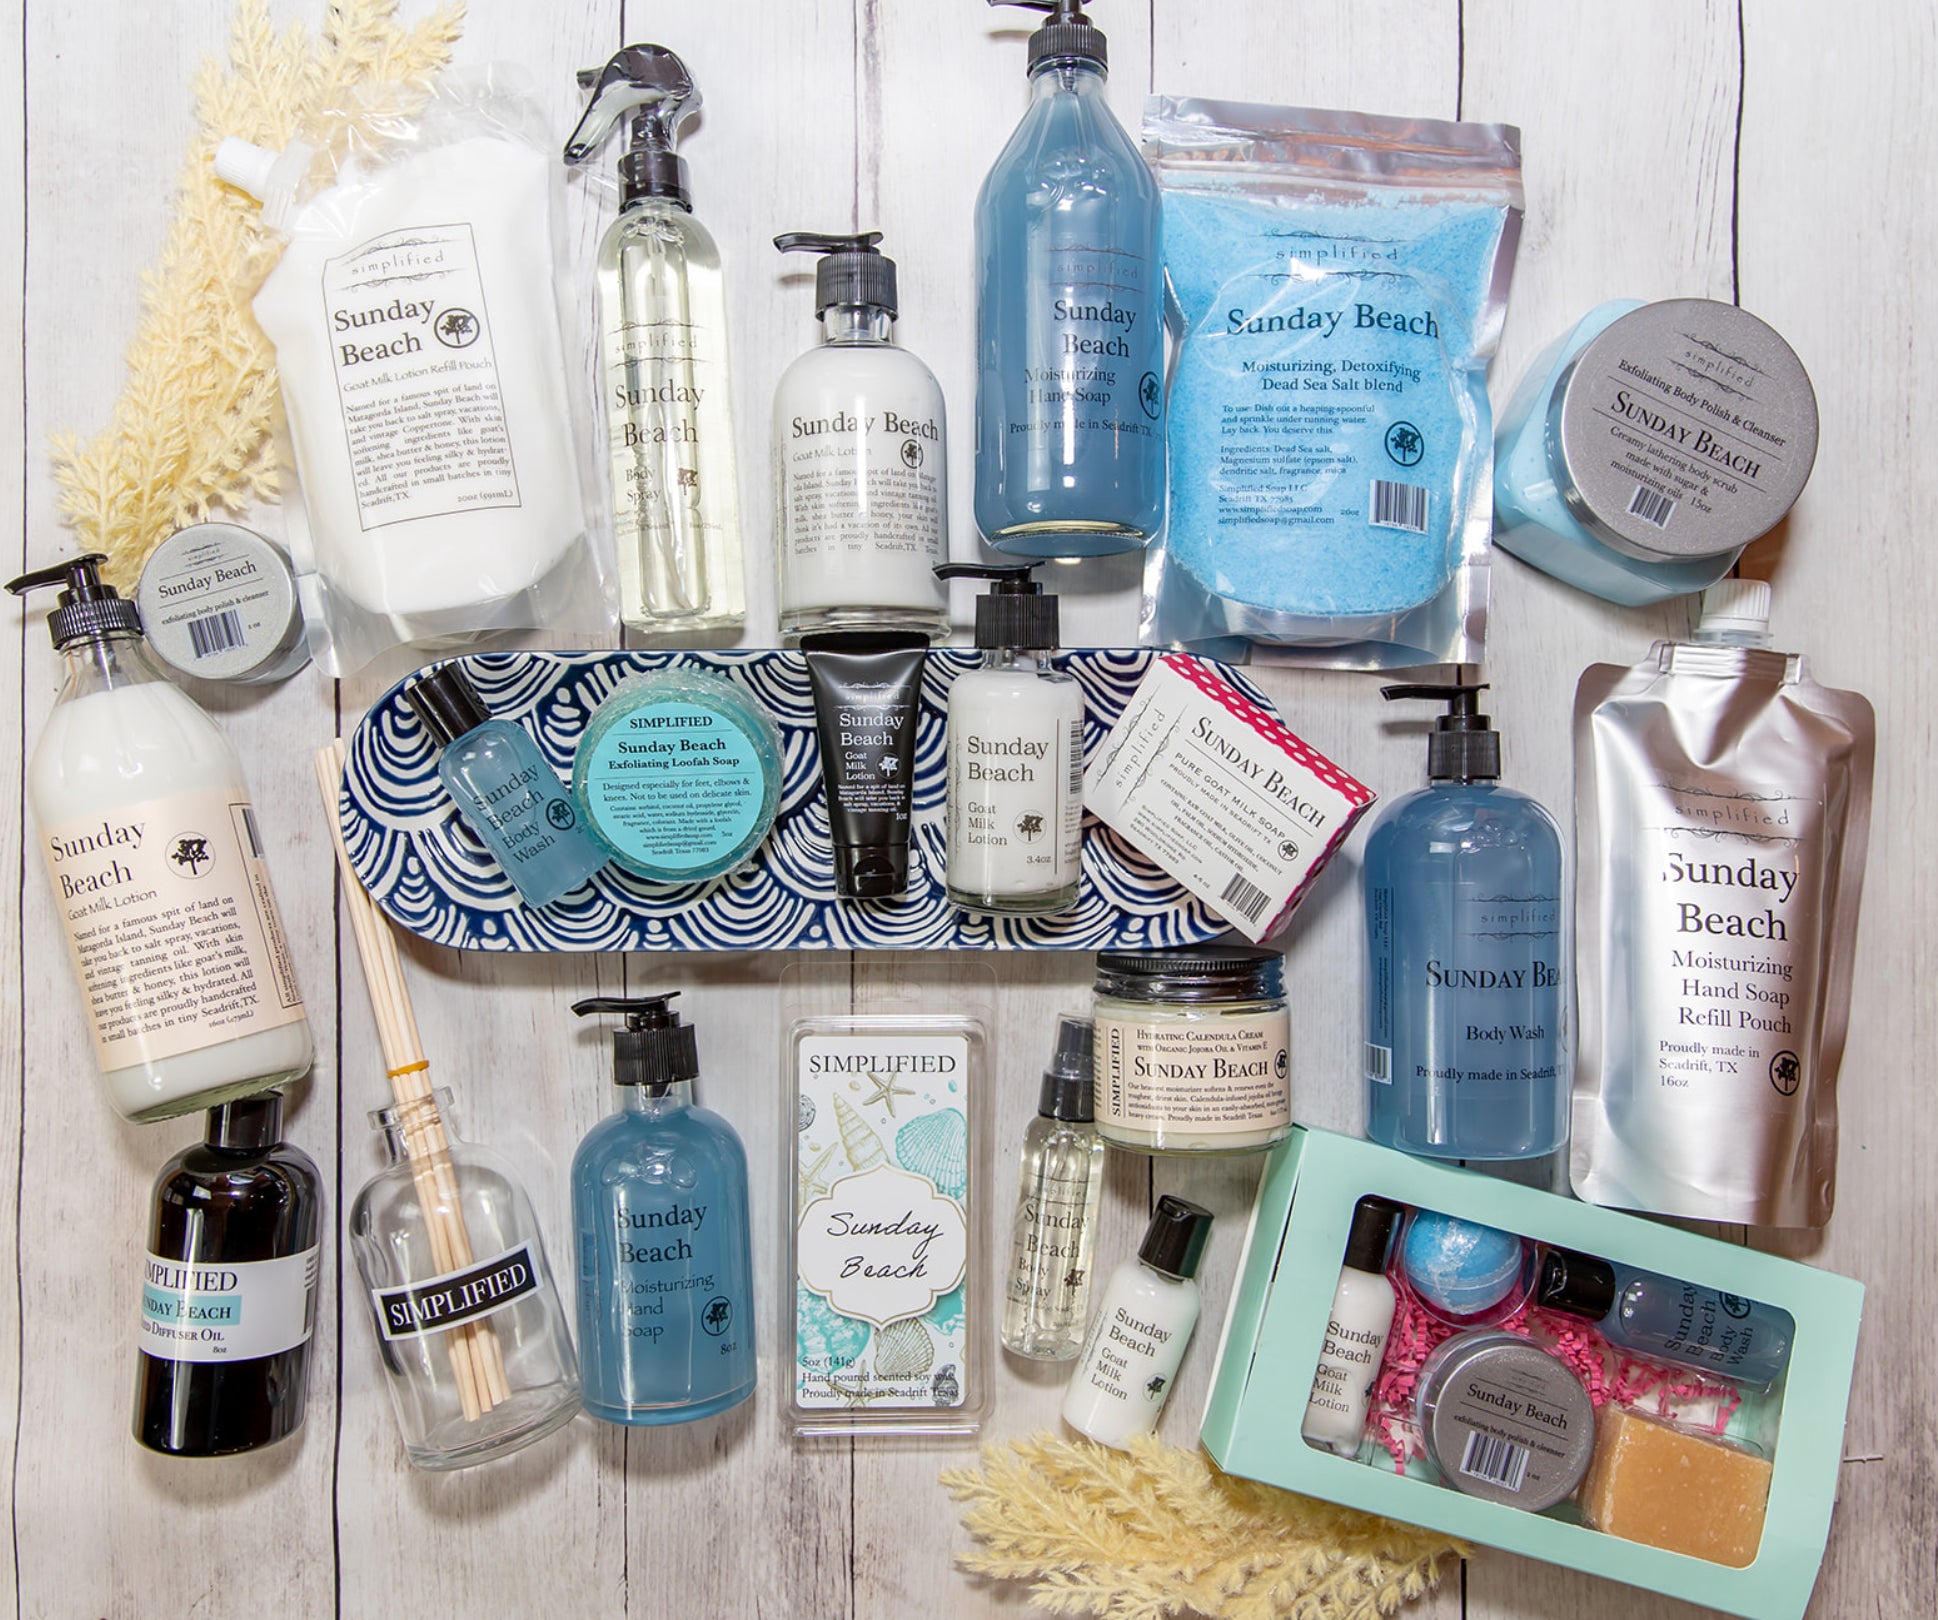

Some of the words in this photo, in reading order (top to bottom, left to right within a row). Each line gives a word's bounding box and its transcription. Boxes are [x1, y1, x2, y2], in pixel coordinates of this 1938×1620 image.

[351, 252, 444, 275] simplified
[1276, 245, 1398, 266] simplified
[335, 299, 435, 332] Sunday
[1054, 300, 1136, 332] Sunday
[1226, 308, 1344, 338] Sunday
[1354, 304, 1440, 339] Beach
[339, 332, 422, 367] Beach
[1062, 333, 1130, 358] Beach
[343, 377, 369, 393] Goat
[370, 374, 393, 388] Milk
[394, 368, 429, 383] Lotion
[430, 362, 457, 374] Refill
[459, 357, 492, 371] Pouch
[1242, 360, 1336, 376] Moisturizing,
[1342, 360, 1421, 382] Detoxifying
[1685, 350, 1754, 388] simplified
[615, 379, 705, 410] Sunday
[1075, 387, 1111, 406] Soap
[1262, 379, 1298, 391] Dead
[1303, 380, 1328, 391] Sea
[1332, 379, 1359, 390] Salt
[1364, 378, 1402, 393] blend
[1618, 359, 1673, 394] Exfoliating
[1672, 386, 1700, 407] Body
[1699, 399, 1731, 422] Polish
[1733, 414, 1742, 426] &
[1742, 419, 1786, 447] Cleanser
[623, 419, 698, 447] Beach
[792, 411, 875, 438] Sunday
[883, 411, 939, 441] Beach
[1610, 426, 1647, 451] Creamy
[1647, 439, 1688, 472] lathering
[1689, 459, 1712, 482] body
[1713, 475, 1739, 495] scrub
[1625, 450, 1652, 467] made
[1653, 463, 1673, 479] with
[1673, 473, 1699, 492] sugar
[1700, 486, 1710, 496] &
[626, 466, 656, 482] Body
[1610, 459, 1666, 494] moisturizing
[1667, 486, 1683, 499] oils
[627, 488, 661, 505] Spray
[159, 576, 212, 599] Sunday
[215, 561, 257, 583] Beach
[162, 611, 196, 625] exfoliating
[198, 606, 213, 616] body
[215, 599, 235, 611] polish
[630, 716, 712, 729] SIMPLIFIED
[839, 713, 904, 730] Sunday
[618, 741, 675, 756] Sunday
[680, 738, 726, 750] Beach
[840, 732, 893, 746] Beach
[967, 736, 1049, 760] Sunday
[1115, 709, 1166, 787] simplified
[609, 760, 669, 770] Exfoliating
[673, 757, 710, 767] Loofah
[713, 756, 739, 767] Soap
[845, 752, 867, 760] Goat
[846, 762, 866, 770] Milk
[846, 772, 875, 780] Lotion
[968, 762, 1034, 782] Beach
[1169, 763, 1200, 787] PROUDLY
[1200, 787, 1220, 806] MADE
[473, 764, 540, 811] Sunday
[603, 782, 640, 792] Designed
[642, 780, 679, 790] especially
[682, 779, 693, 787] for
[1175, 753, 1201, 776] PURE
[1203, 774, 1230, 797] GOAT
[1231, 795, 1258, 818] MILK
[1259, 817, 1286, 839] SOAP
[486, 790, 544, 831] Beach
[968, 802, 996, 814] Goat
[1675, 804, 1789, 825] simplified
[502, 821, 540, 849] Body
[968, 818, 994, 829] Milk
[50, 821, 146, 862] Sunday
[512, 835, 556, 863] Wash
[968, 833, 1008, 846] Lotion
[1027, 856, 1052, 864] 3.4oz
[60, 860, 133, 899] Beach
[1663, 853, 1799, 903] Sunday
[68, 908, 88, 921] Goat
[89, 900, 112, 917] Milk
[114, 889, 157, 907] Lotion
[122, 914, 158, 930] famous
[199, 899, 220, 911] land
[149, 920, 185, 935] Sunday
[189, 910, 219, 925] Beach
[1481, 908, 1556, 928] simplified
[1677, 902, 1788, 941] Beach
[130, 951, 168, 967] tanning
[1671, 950, 1793, 982] Moisturizing
[1681, 978, 1739, 1000] Hand
[1746, 982, 1790, 1009] Soap
[1678, 1006, 1732, 1027] Refill
[1738, 1011, 1792, 1033] Pouch
[1466, 1025, 1507, 1044] Body
[1509, 1025, 1545, 1040] Wash
[1660, 1040, 1708, 1056] Proudly
[1712, 1043, 1746, 1057] made
[1748, 1046, 1760, 1058] in
[810, 1055, 956, 1073] SIMPLIFIED
[1112, 1028, 1121, 1116] SIMPLIFIED
[1468, 1070, 1502, 1080] made
[1506, 1070, 1517, 1080] in
[1659, 1057, 1712, 1073] Seadrift,
[1715, 1060, 1738, 1073] TX
[1660, 1075, 1689, 1088] 16oz
[618, 1205, 707, 1231] Sunday
[827, 1210, 944, 1259] Sunday
[1027, 1234, 1080, 1258] Beach
[620, 1239, 692, 1263] Beach
[840, 1255, 928, 1278] Beach
[390, 1264, 527, 1327] SIMPLIFIED
[621, 1274, 715, 1294] Moisturizing
[1115, 1307, 1172, 1344] Sunday
[1664, 1283, 1697, 1351] Sunday
[1685, 1300, 1717, 1356] Beach
[1109, 1325, 1156, 1357] Beach
[1327, 1320, 1383, 1348] Sunday
[1709, 1325, 1737, 1362] Body
[1727, 1327, 1753, 1365] Wash
[802, 1357, 820, 1367] 5oz
[1102, 1347, 1128, 1368] Goat
[1323, 1340, 1372, 1364] Beach
[802, 1372, 830, 1382] Hand
[834, 1372, 870, 1386] poured
[873, 1372, 911, 1382] scented
[914, 1373, 931, 1384] soy
[1096, 1360, 1121, 1382] Milk
[1317, 1363, 1348, 1381] Goat
[802, 1388, 841, 1400] Proudly
[845, 1389, 873, 1398] made
[875, 1388, 885, 1397] in
[888, 1387, 928, 1397] Seadrift
[1091, 1374, 1127, 1400] Lotion
[1313, 1378, 1342, 1396] Milk
[1309, 1392, 1349, 1412] Lotion
[1467, 1383, 1522, 1416] Sunday
[1525, 1403, 1568, 1430] Beach
